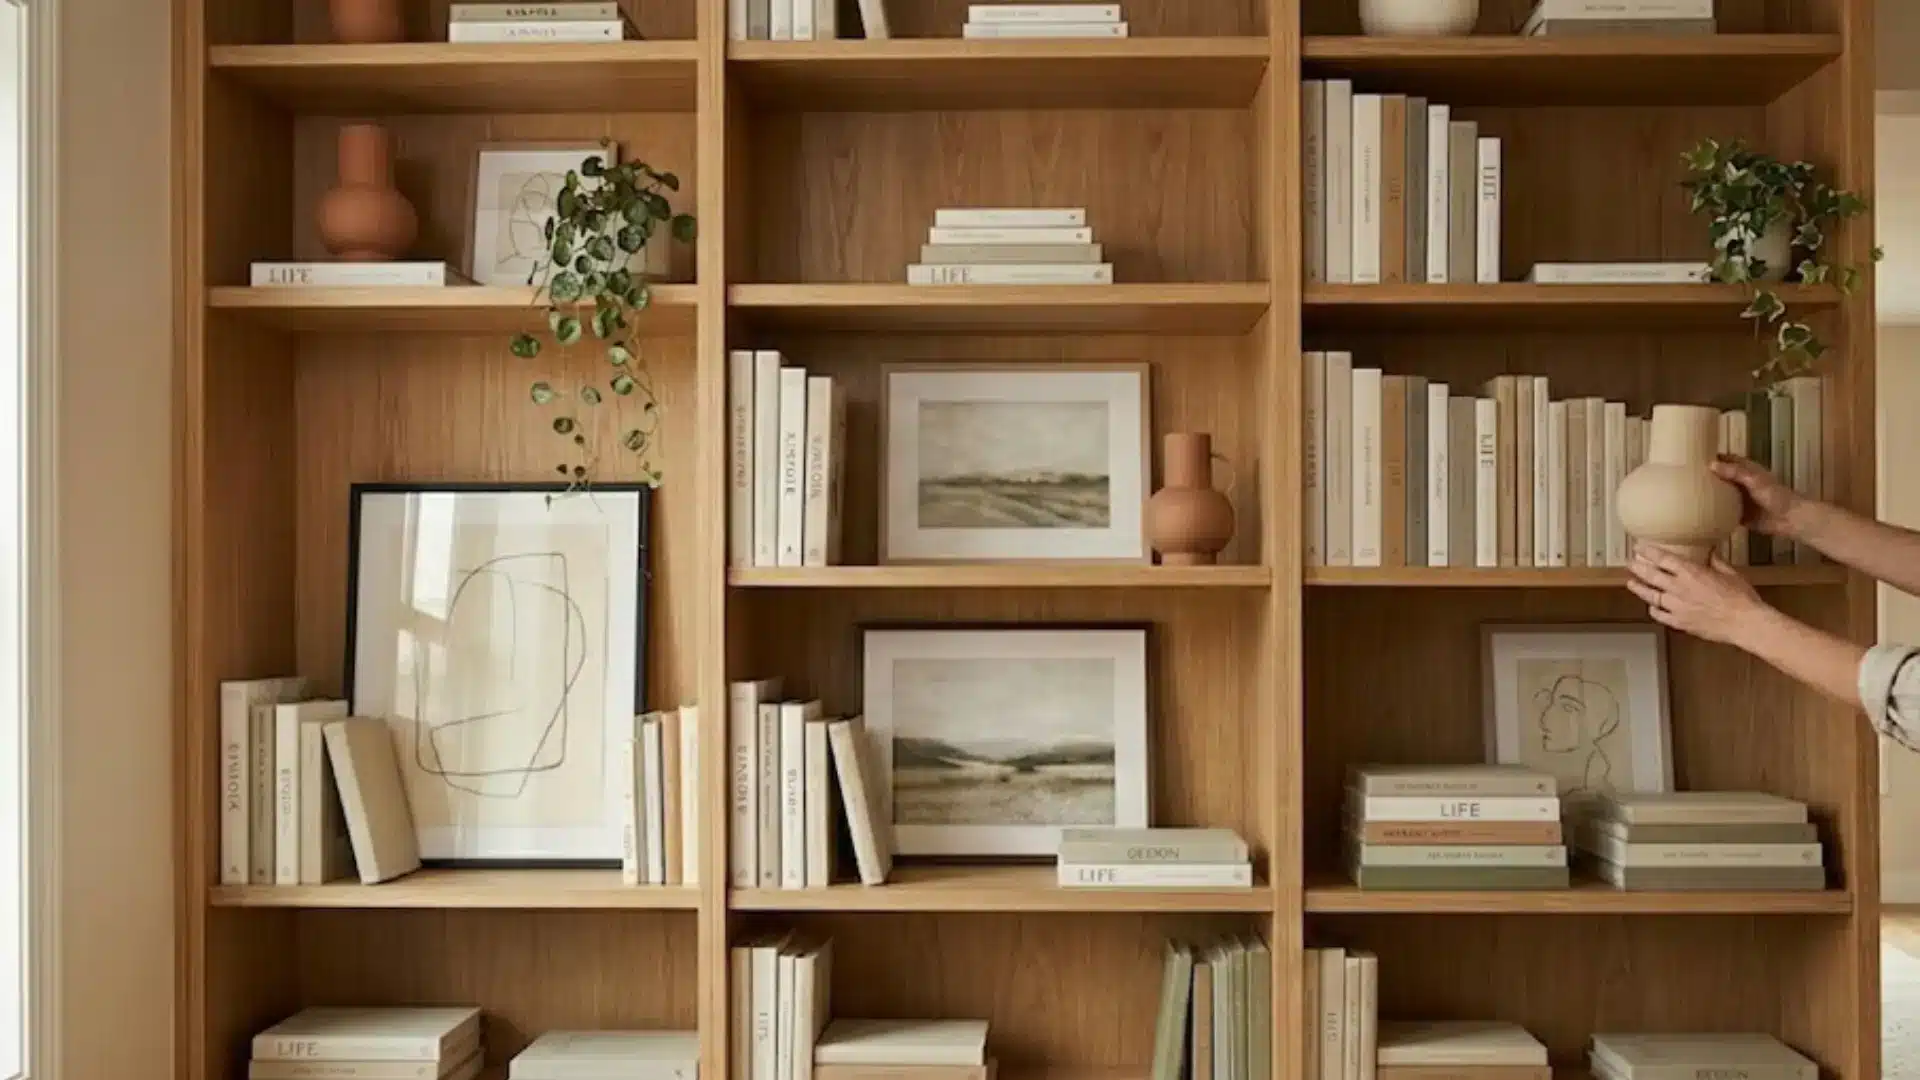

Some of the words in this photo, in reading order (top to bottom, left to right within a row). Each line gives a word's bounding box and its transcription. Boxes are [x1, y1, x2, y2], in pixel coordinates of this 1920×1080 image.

[930, 267, 973, 284] LIFE
[1440, 802, 1481, 817] LIFE
[1079, 868, 1119, 883] LIFE
[277, 1041, 320, 1057] LIFE
